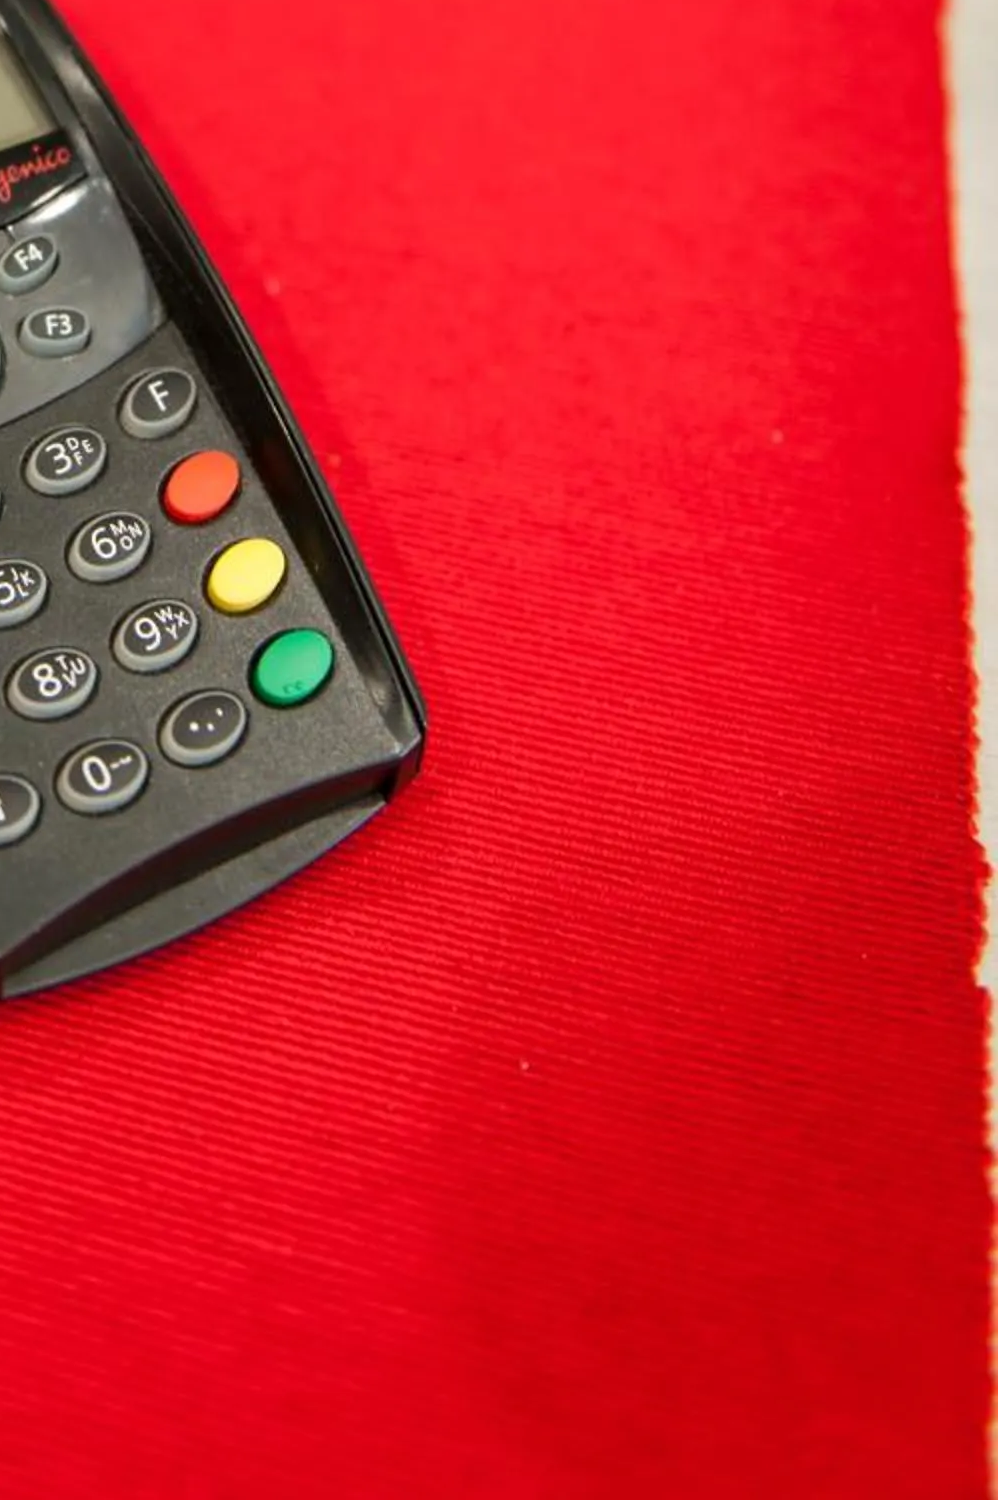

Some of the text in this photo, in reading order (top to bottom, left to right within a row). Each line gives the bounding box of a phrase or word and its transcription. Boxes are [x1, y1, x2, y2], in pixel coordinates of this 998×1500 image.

[14, 243, 44, 271] F4
[45, 313, 74, 336] F3
[147, 380, 170, 412] F
